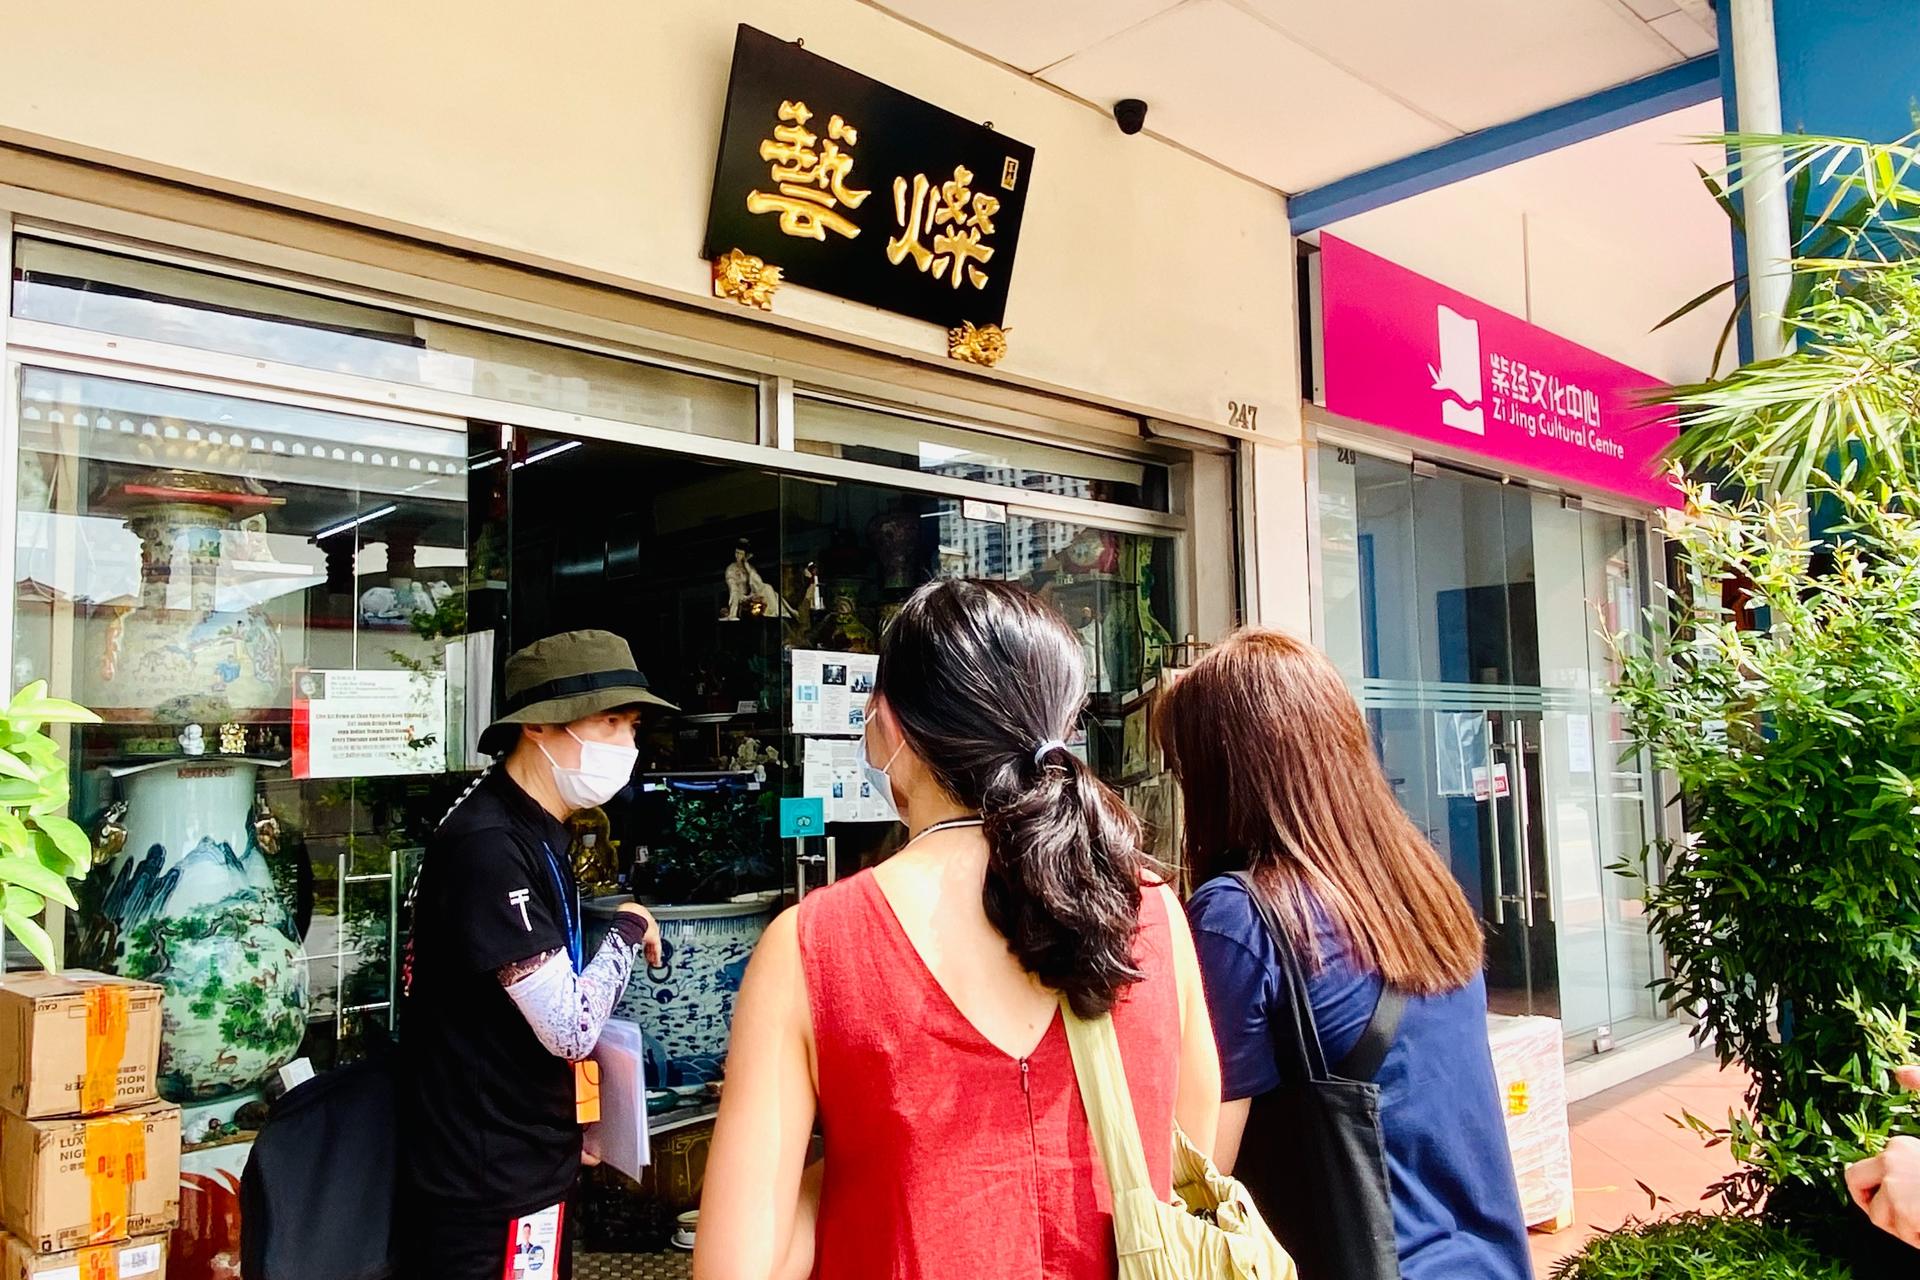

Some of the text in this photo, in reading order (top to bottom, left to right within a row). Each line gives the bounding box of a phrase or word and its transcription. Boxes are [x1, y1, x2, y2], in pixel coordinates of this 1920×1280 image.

[1490, 353, 1600, 428] 紫经文化中心
[1228, 401, 1258, 430] 247
[1492, 397, 1624, 460] Zi Jing Cultural Centre
[1337, 447, 1356, 464] 249
